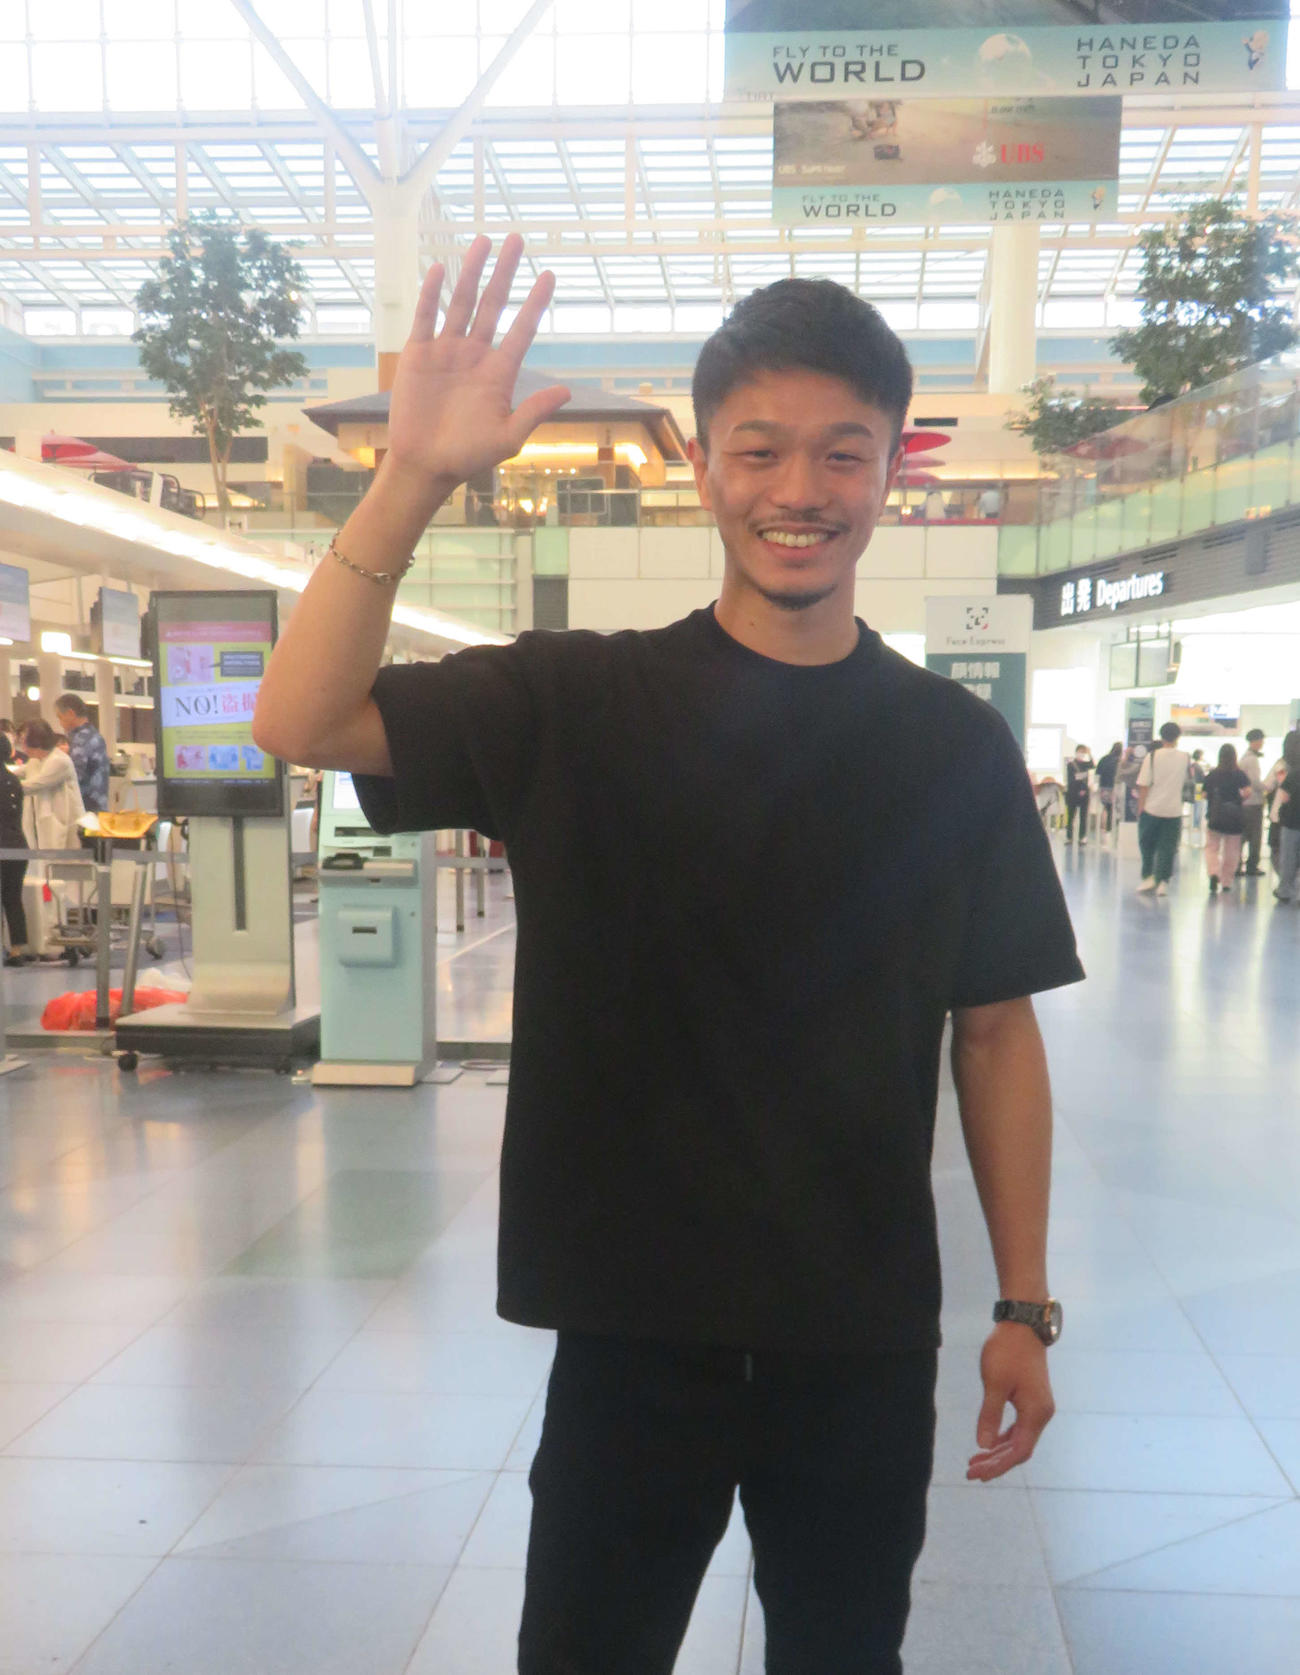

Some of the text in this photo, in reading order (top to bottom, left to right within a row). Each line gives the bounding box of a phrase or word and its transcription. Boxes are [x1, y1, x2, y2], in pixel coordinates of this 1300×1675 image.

[1077, 35, 1200, 51] HANEDA
[773, 44, 899, 58] FLY TO THE
[1077, 53, 1201, 69] TOKYO
[773, 60, 926, 83] WORLD
[1077, 71, 1200, 87] JAPAN
[1000, 143, 1045, 164] UBS
[802, 193, 881, 203] FLY TO THE
[989, 189, 1064, 199] HANEDA
[802, 203, 897, 217] WORLD
[989, 200, 1065, 210] TOKYO
[989, 210, 1065, 220] JAPAN
[1096, 571, 1165, 611] Departures
